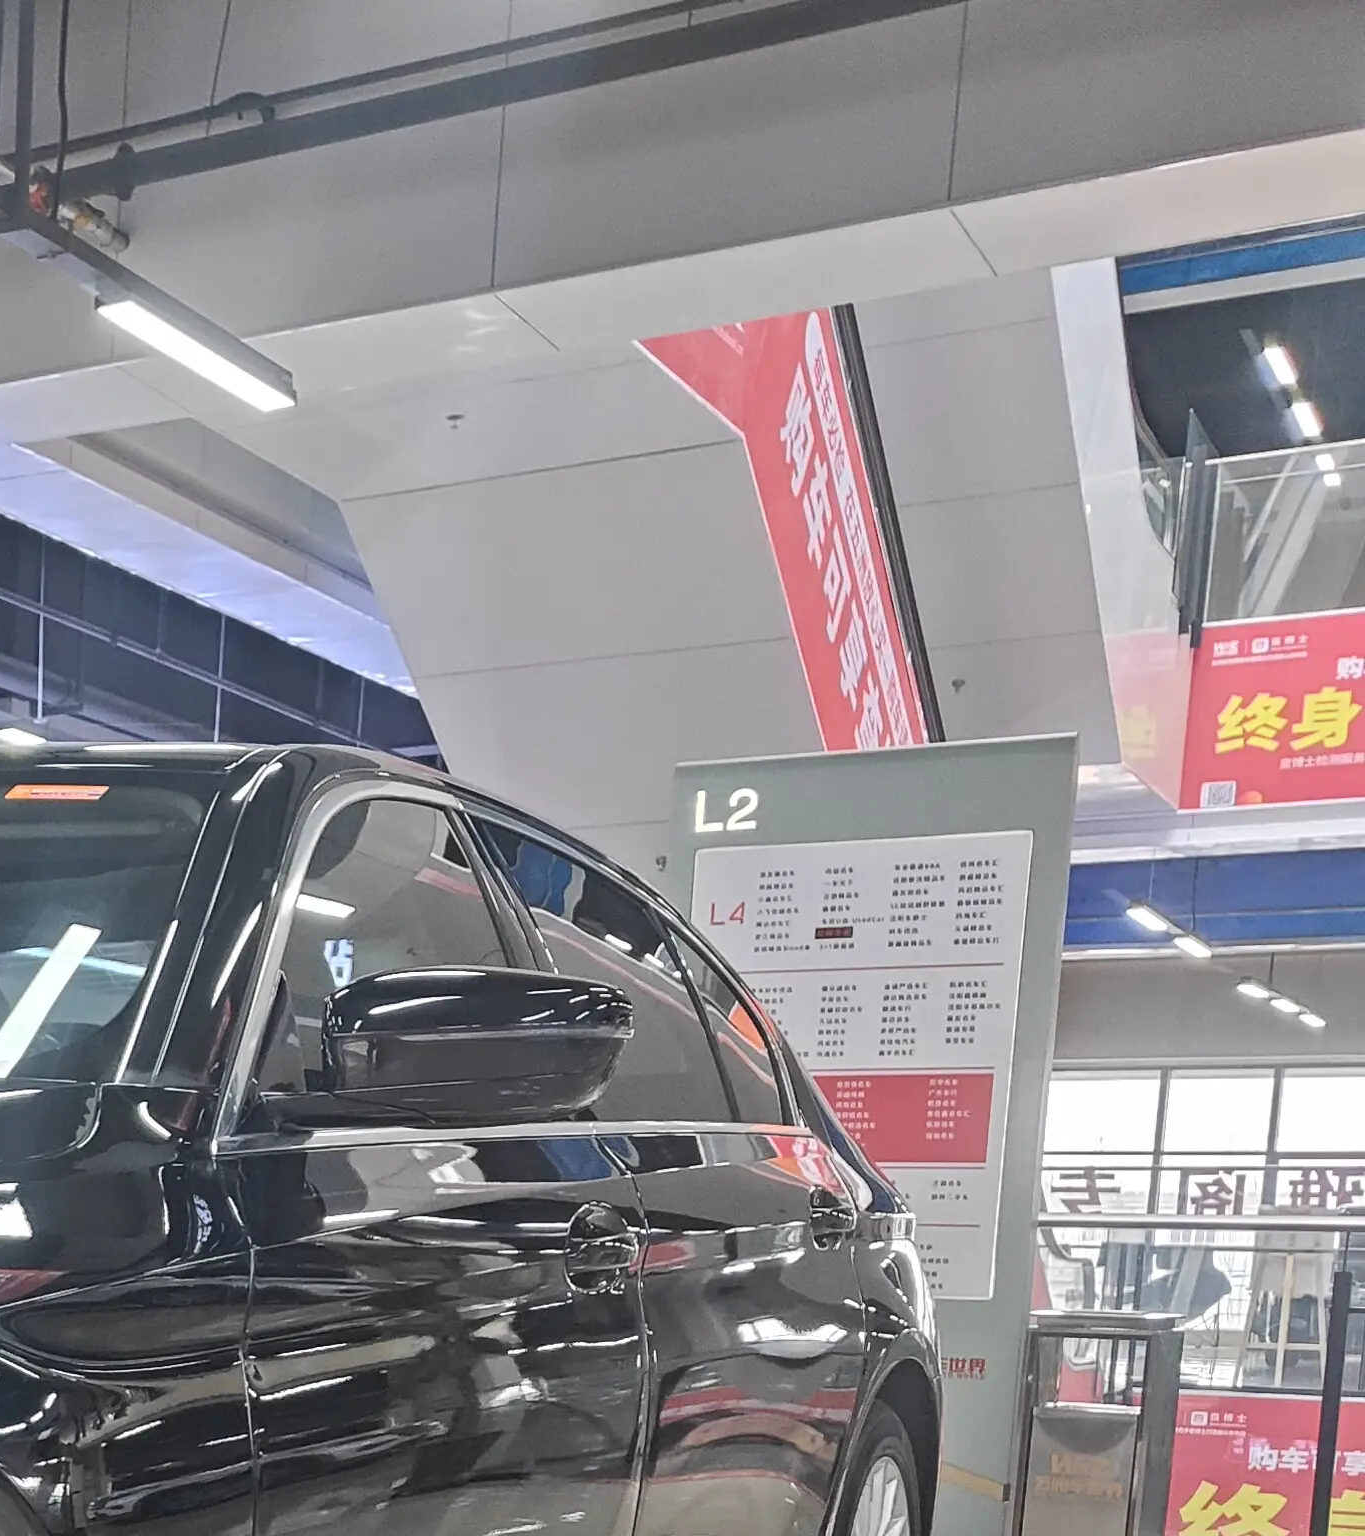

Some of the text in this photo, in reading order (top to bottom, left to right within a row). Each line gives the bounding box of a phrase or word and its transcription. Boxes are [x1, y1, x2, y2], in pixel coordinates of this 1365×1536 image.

[1215, 686, 1364, 754] 终身
[695, 787, 759, 833] L2
[710, 901, 746, 926] L4
